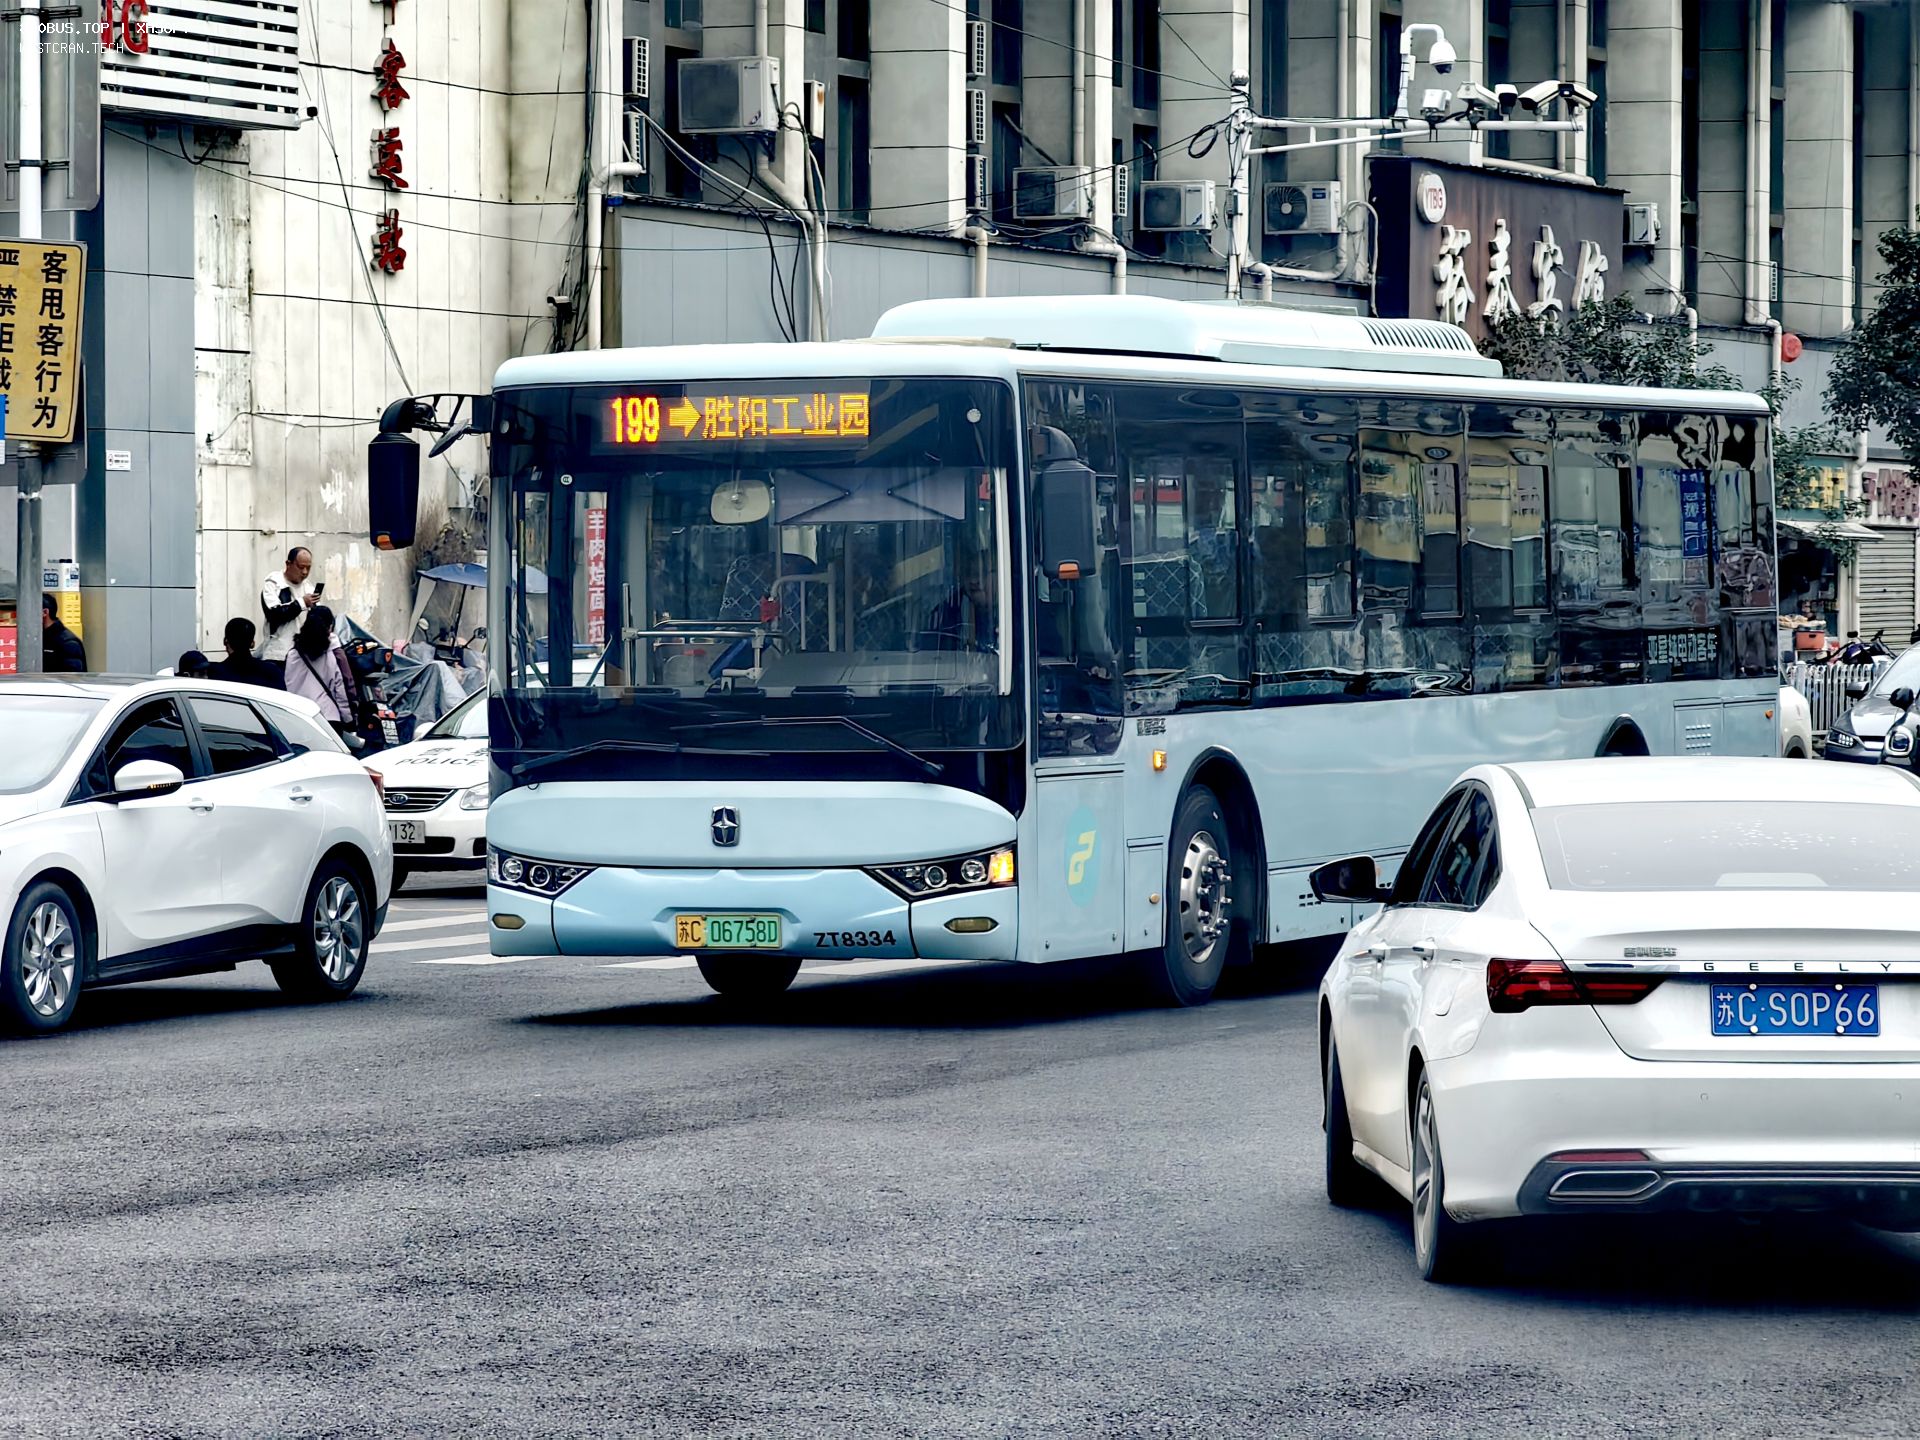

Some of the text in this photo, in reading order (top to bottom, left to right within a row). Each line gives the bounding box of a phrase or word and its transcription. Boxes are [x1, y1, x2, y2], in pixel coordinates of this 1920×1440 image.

[370, 0, 410, 272] 客运站
[32, 250, 68, 429] 客甩客行为
[611, 397, 660, 443] 199
[701, 393, 869, 438] 胜阳工业园
[395, 757, 485, 766] POLICE
[388, 822, 415, 840] 132
[814, 930, 897, 948] ZT8334
[1703, 962, 1892, 972] GEELY
